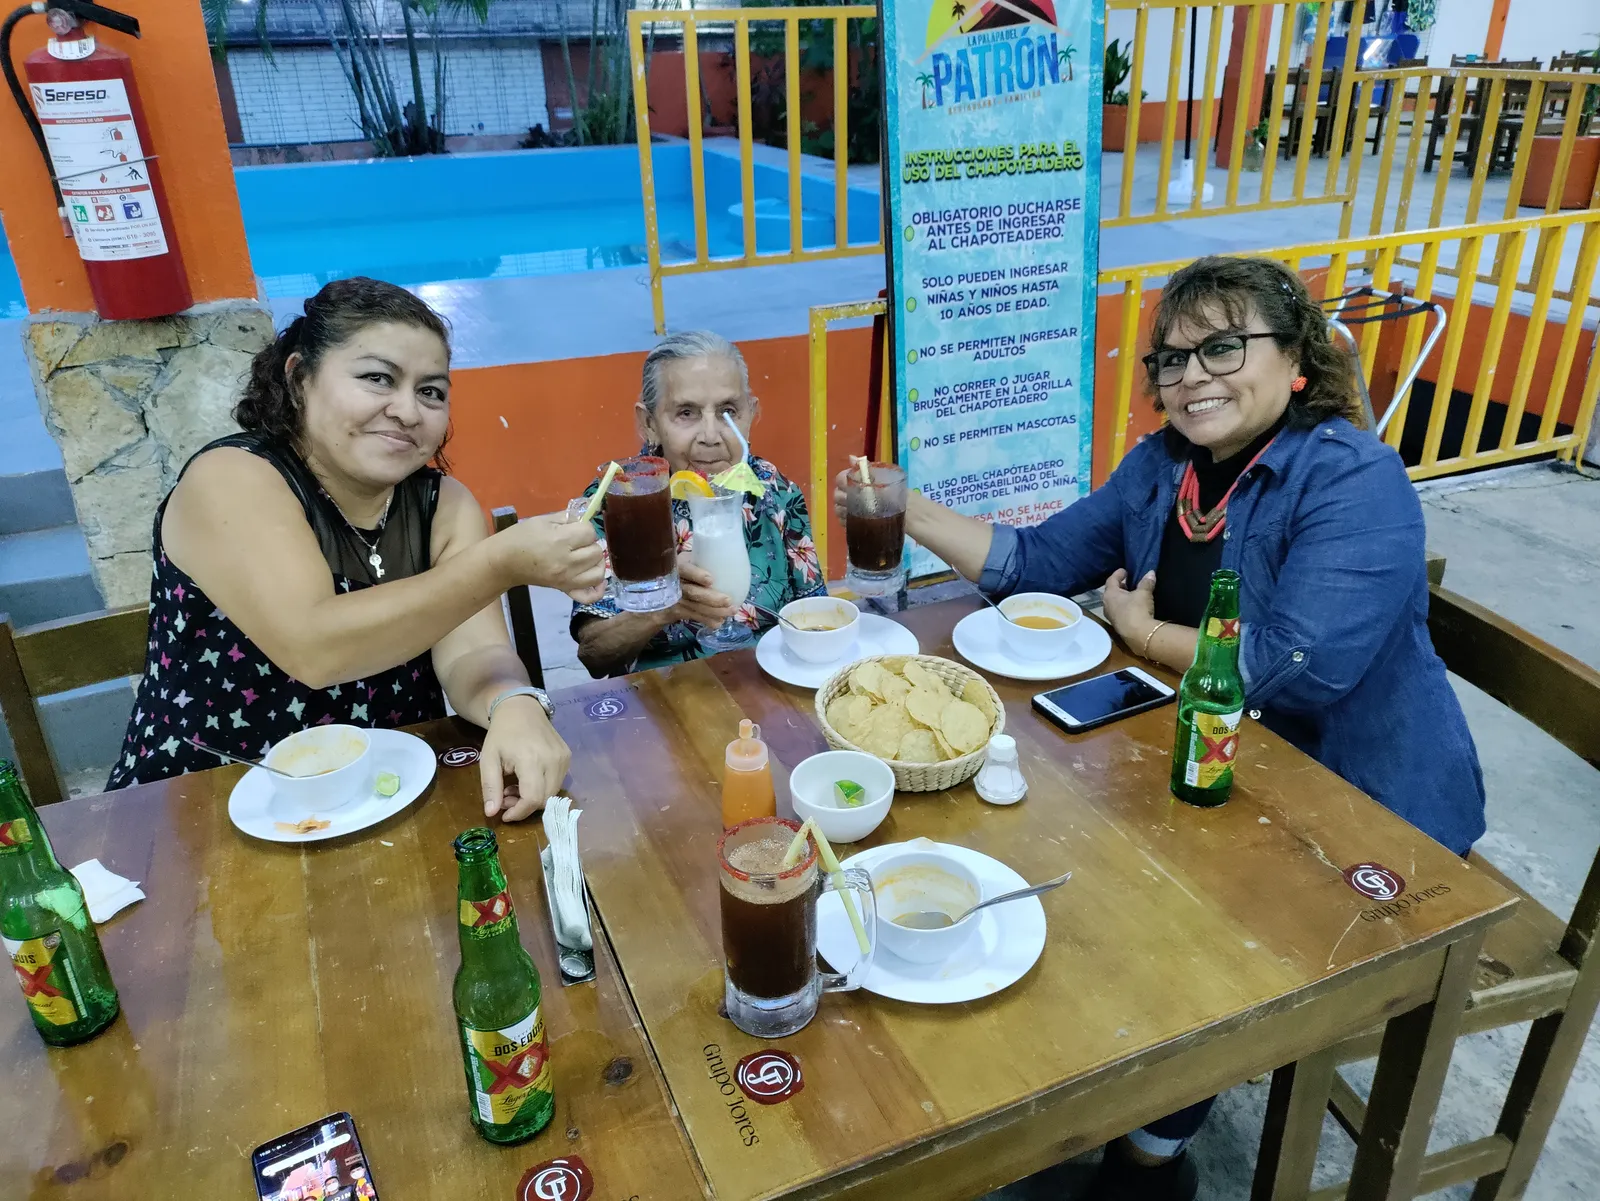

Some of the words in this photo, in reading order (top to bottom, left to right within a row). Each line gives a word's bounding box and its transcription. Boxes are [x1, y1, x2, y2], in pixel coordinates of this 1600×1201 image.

[977, 31, 1005, 45] PALAPA
[932, 26, 1060, 107] PATRÓN
[905, 145, 1014, 168] INSTRUCCIONES
[1019, 142, 1058, 158] PARA
[1063, 140, 1081, 155] EL
[902, 165, 930, 184] USO
[935, 164, 961, 181] DEL
[966, 154, 1085, 178] CHAPOTEADERO
[912, 205, 1003, 226] OBLIGATORIO
[1008, 198, 1081, 216] DUCHARSE
[926, 221, 972, 238] ANTES
[976, 219, 995, 233] DE
[999, 212, 1066, 230] INGRESAR
[927, 238, 946, 252] AL
[951, 227, 1065, 249] CHAPOTEADERO.
[922, 275, 954, 289] SOLO
[957, 269, 1006, 286] PUEDEN
[1009, 262, 1069, 280] INGRESAR
[927, 289, 964, 306] NIÑAS
[968, 289, 977, 300] Y
[981, 283, 1018, 300] NIÑOS
[1022, 279, 1059, 294] HASTA
[940, 310, 953, 321] 10
[957, 302, 992, 319] AÑOS
[996, 302, 1011, 314] DE
[1015, 297, 1051, 311] EDAD.
[920, 347, 936, 359] NO
[940, 344, 954, 355] SE
[957, 335, 1016, 353] PERMITEN
[1019, 327, 1079, 344] INGRESAR
[973, 345, 1026, 362] ADULTOS
[913, 390, 993, 412] BRUSCAMENTE
[995, 387, 1011, 398] EN
[1014, 384, 1029, 395] LA
[1032, 378, 1073, 392] ORILLA
[934, 386, 950, 398] NO
[953, 378, 996, 393] CORRER
[1000, 376, 1009, 386] O
[1012, 370, 1050, 385] JUGAR
[936, 408, 956, 419] DEL
[959, 392, 1049, 415] CHAPOTEADERO
[924, 437, 940, 449] NO
[943, 434, 956, 445] SE
[959, 424, 1014, 442] PERMITEN
[1016, 414, 1077, 432] MASCOTAS
[923, 483, 936, 494] EL
[937, 478, 958, 490] USO
[961, 474, 980, 485] DEL
[930, 491, 941, 501] ES
[944, 474, 1037, 499] RESPONSABILIDAD
[1039, 470, 1058, 481] DEL
[945, 499, 954, 508] O
[956, 490, 990, 505] TUTOR
[992, 488, 1011, 498] DEL
[1042, 480, 1050, 489] O
[1052, 474, 1079, 488] NIÑA
[998, 508, 1014, 519] NO
[1018, 505, 1030, 515] SE
[1034, 499, 1064, 512] HACE
[1360, 899, 1412, 922] Grupo
[494, 1040, 518, 1057] DOS
[521, 1017, 543, 1048] EQUIS
[702, 1043, 736, 1096] Grupo
[726, 1096, 760, 1147] Jores
